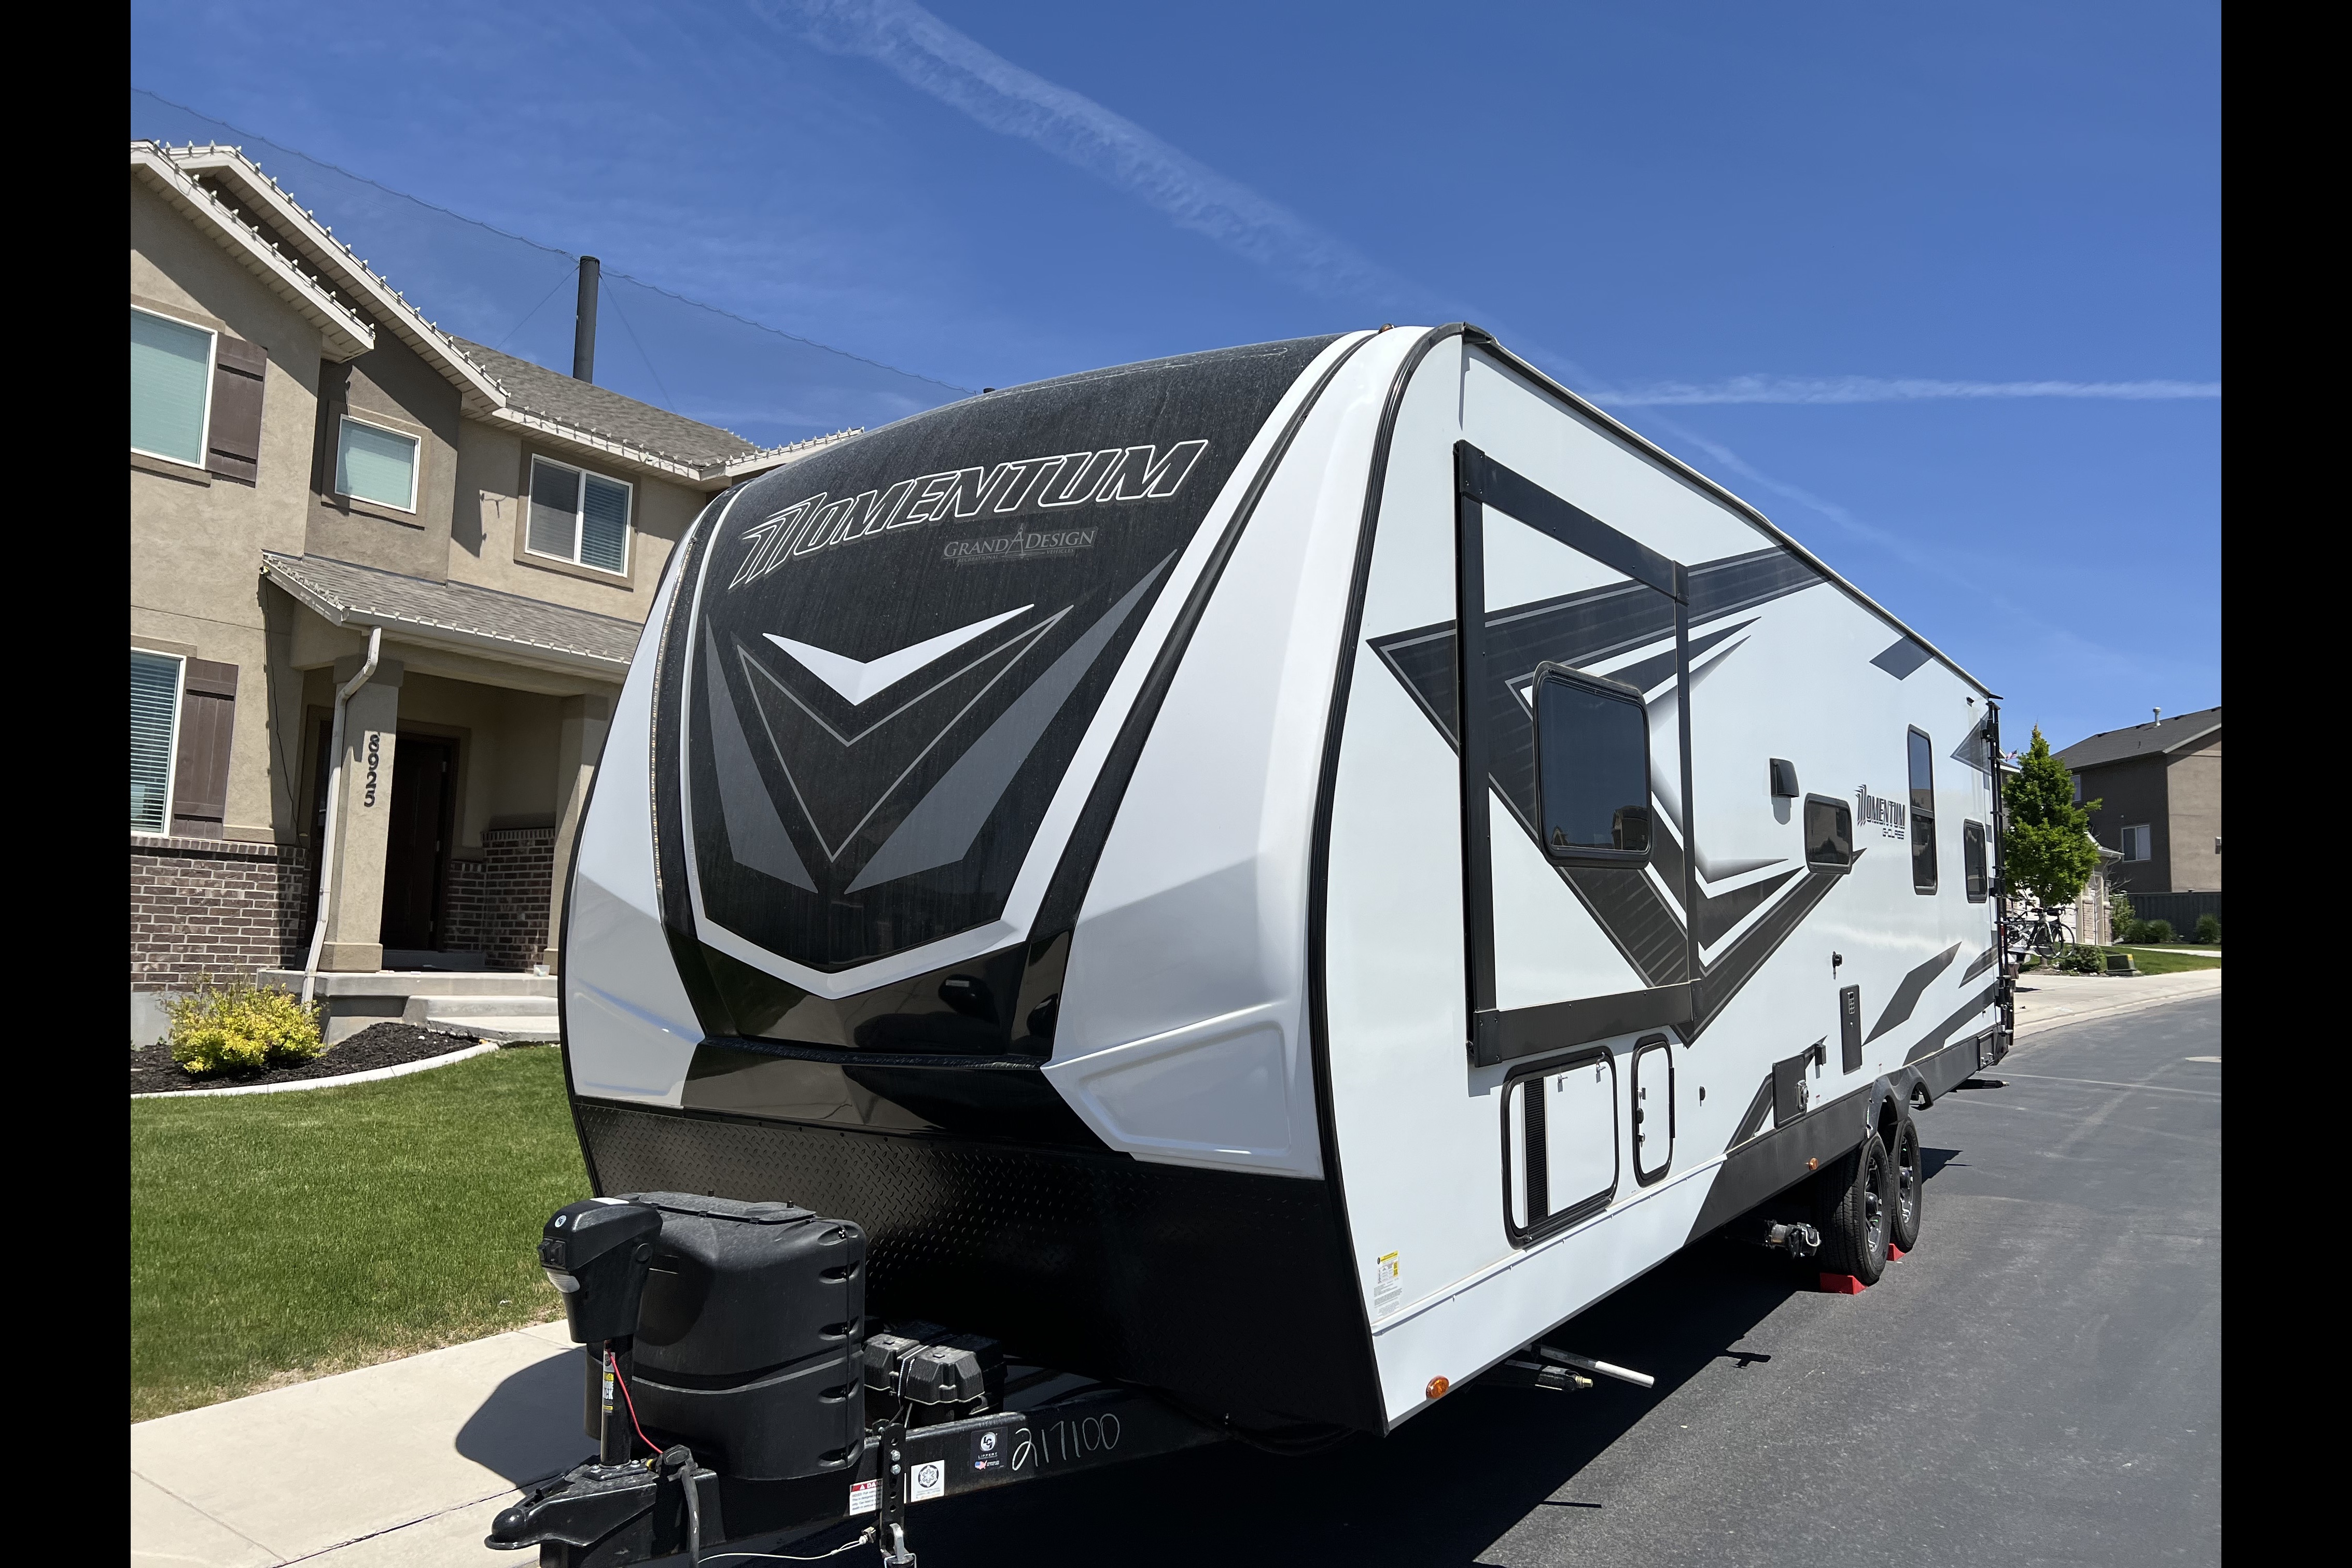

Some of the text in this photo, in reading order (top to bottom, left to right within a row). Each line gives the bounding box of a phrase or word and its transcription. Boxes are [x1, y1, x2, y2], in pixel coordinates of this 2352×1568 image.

[729, 440, 1209, 590] MOMENTUM
[943, 530, 1096, 557] GRAND DESIGN
[363, 734, 380, 807] 8925
[1012, 1413, 1120, 1471] 217100
